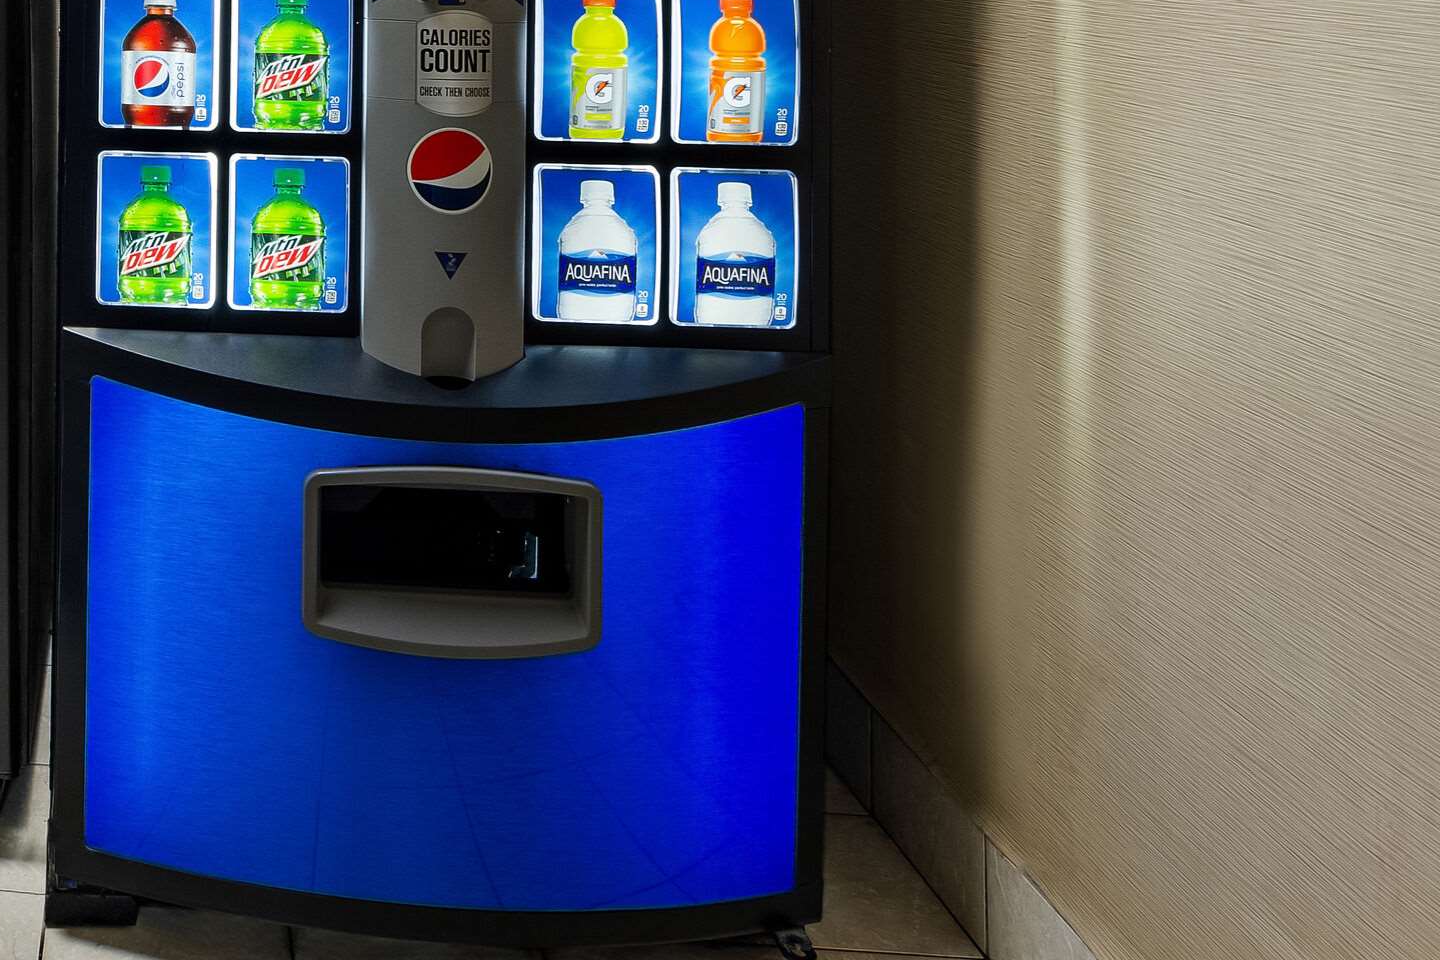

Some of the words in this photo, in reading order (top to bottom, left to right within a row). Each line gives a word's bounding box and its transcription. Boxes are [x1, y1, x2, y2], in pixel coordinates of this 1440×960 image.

[420, 29, 490, 46] CALORIES
[420, 48, 490, 73] COUNT
[174, 62, 185, 98] pepsi
[420, 86, 442, 97] CHECK
[445, 87, 462, 97] THEN
[464, 87, 490, 97] CHOOSE
[638, 104, 649, 113] 20
[777, 108, 788, 116] 20
[565, 263, 631, 283] AQUAFINA
[702, 266, 768, 286] AQUAFINA
